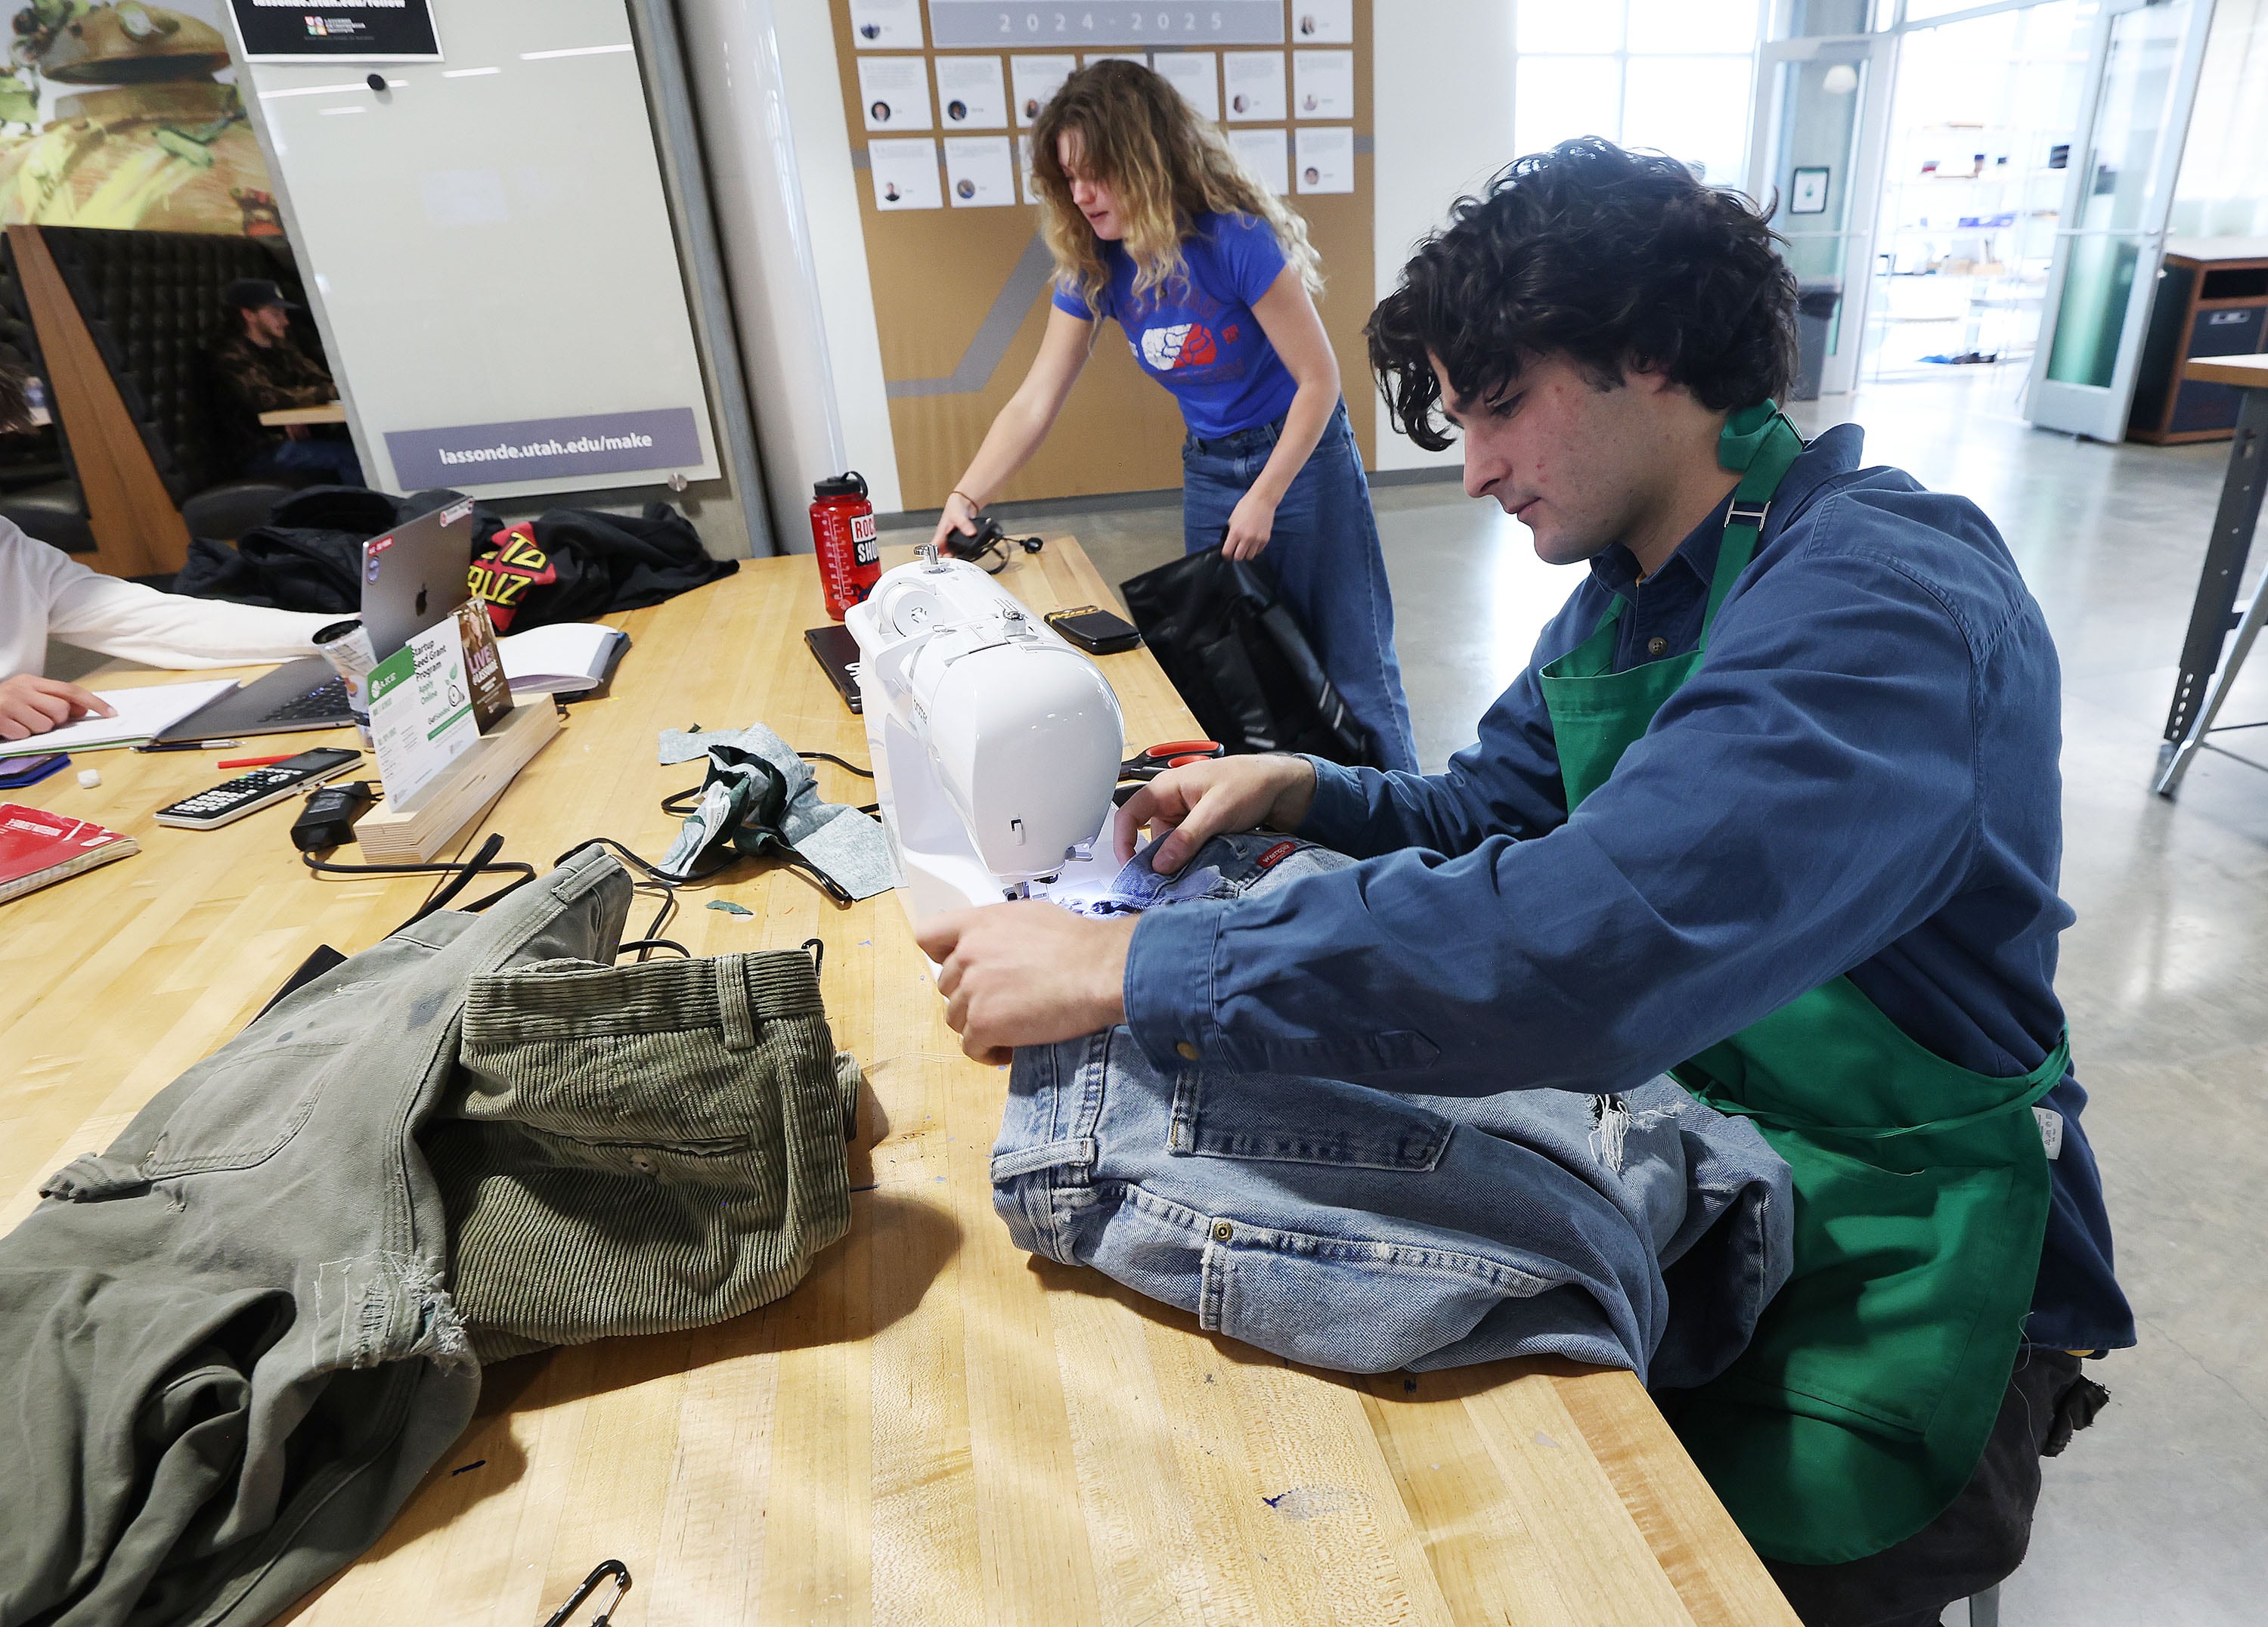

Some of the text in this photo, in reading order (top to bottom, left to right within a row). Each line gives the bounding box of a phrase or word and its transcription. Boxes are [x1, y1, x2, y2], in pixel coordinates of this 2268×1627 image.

[438, 432, 653, 464] lassonde.utah.edu/make
[429, 645, 447, 661] Grant
[467, 646, 492, 674] LIVE
[415, 662, 442, 681] Program
